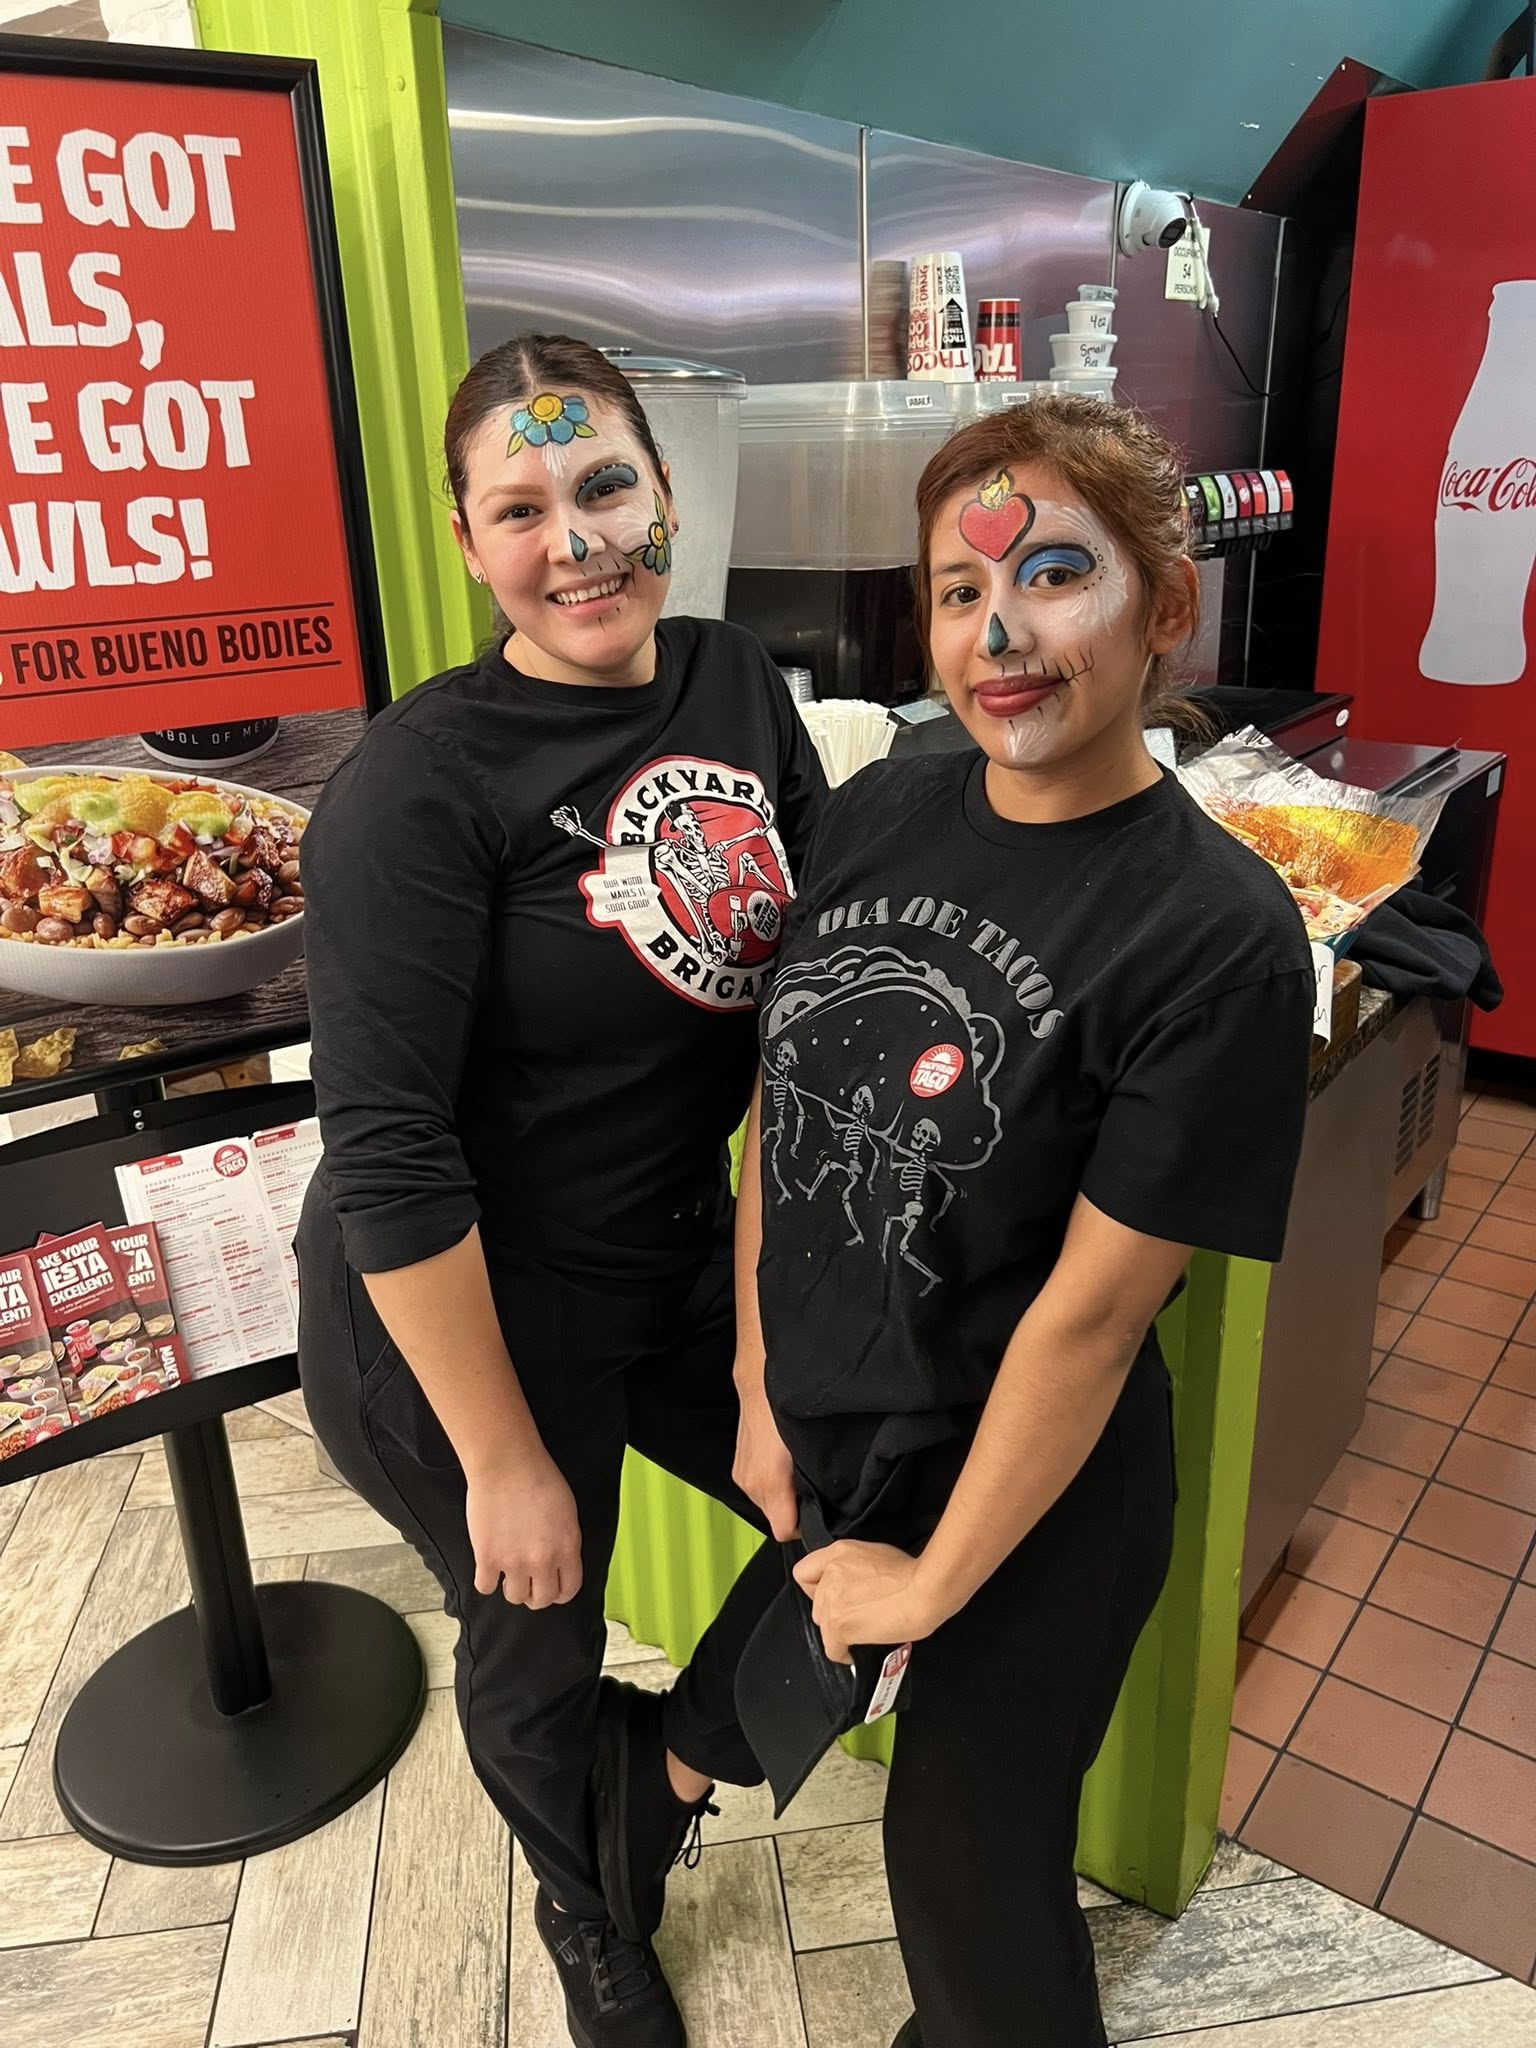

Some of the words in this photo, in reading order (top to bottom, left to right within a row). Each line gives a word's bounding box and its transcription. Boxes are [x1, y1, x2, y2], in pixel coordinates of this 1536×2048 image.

[0, 126, 43, 224] E
[56, 128, 241, 231] GOT
[1183, 263, 1191, 279] 54
[1080, 344, 1106, 357] Small
[0, 381, 63, 474] E
[77, 379, 255, 471] GOT
[1441, 457, 1536, 513] Coca-Col
[0, 496, 213, 594] WLS!
[11, 639, 87, 684] FOR
[91, 627, 208, 676] BUENO
[217, 615, 333, 663] BODIES
[211, 731, 231, 745] OF
[619, 769, 769, 847] BACKYAR
[603, 878, 620, 889] OUR
[620, 875, 643, 886] WOOD
[610, 888, 637, 900] MAKES
[638, 887, 646, 897] IT
[605, 902, 627, 913] SOOO
[760, 906, 779, 939] TACO
[817, 897, 889, 938] DIA
[897, 896, 968, 939] DE
[968, 918, 1065, 1039] TACOS
[912, 1069, 951, 1091] TACO
[220, 1156, 247, 1176] TACO
[61, 1237, 100, 1261] YOUR
[111, 1233, 149, 1252] YOUR
[0, 1283, 29, 1310] TA
[49, 1271, 114, 1307] EXCELLENT!
